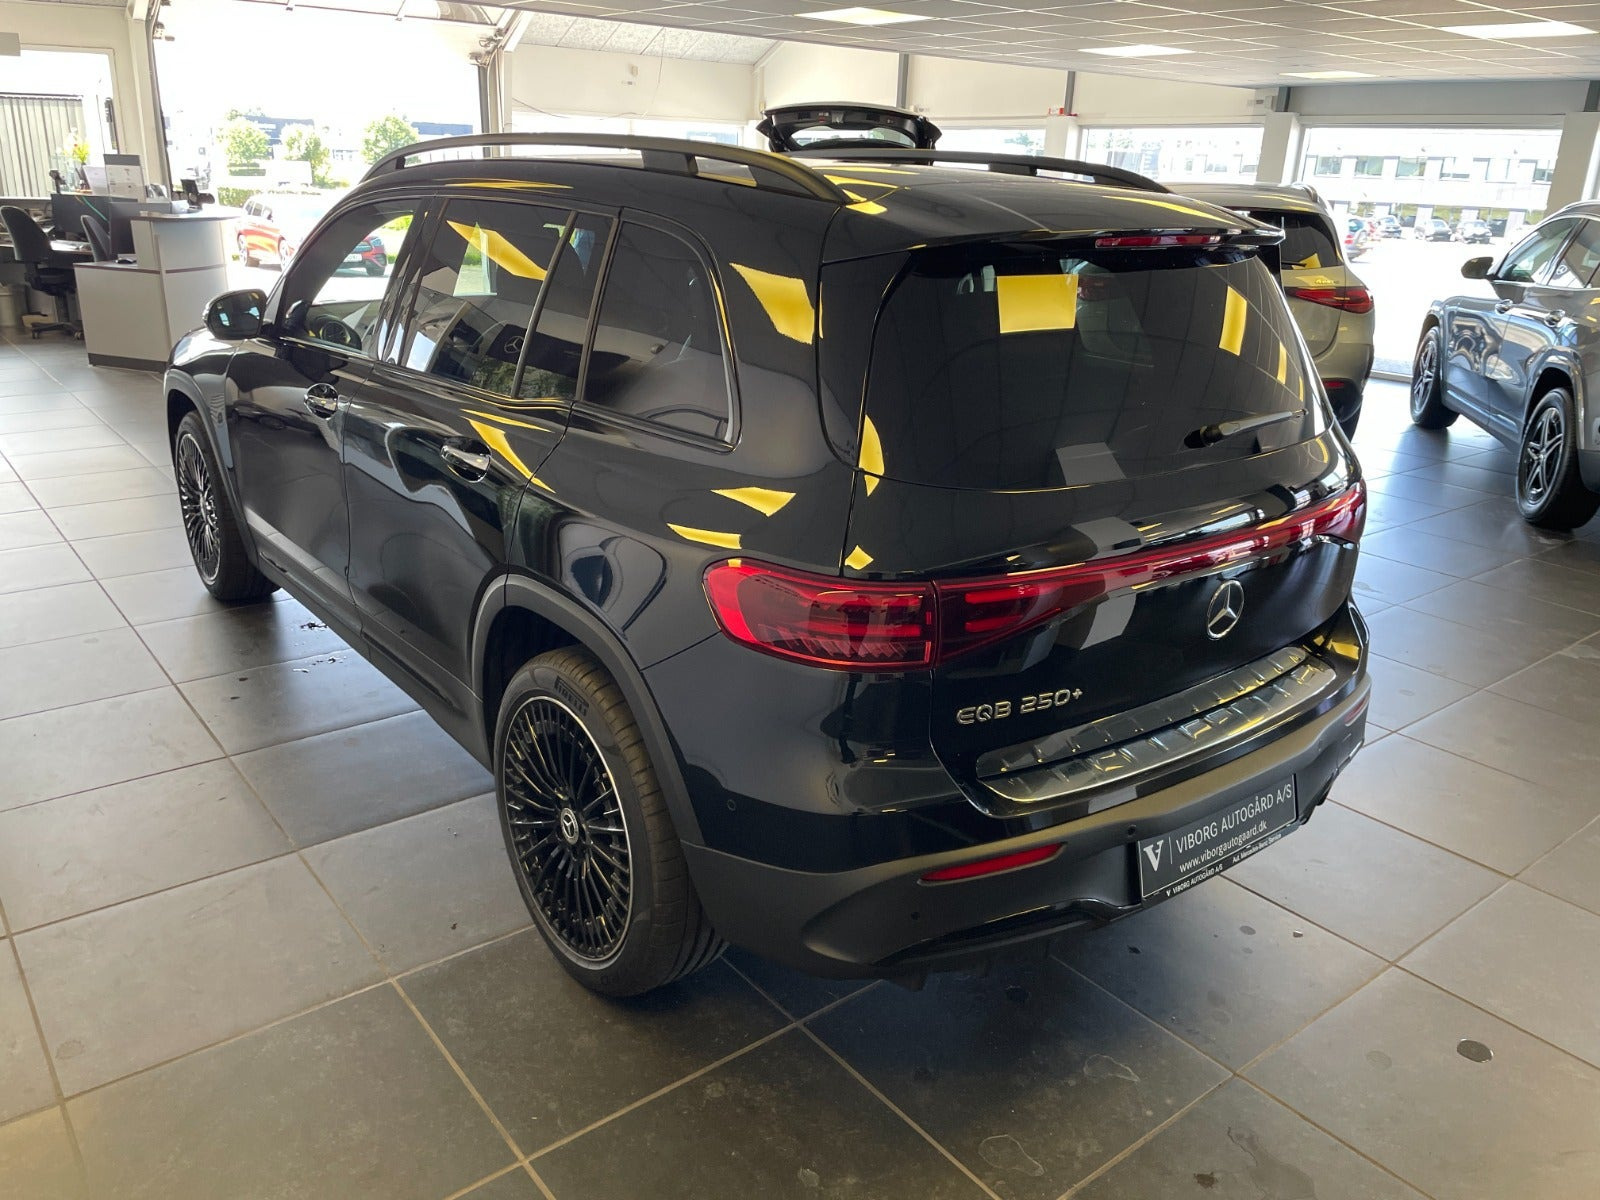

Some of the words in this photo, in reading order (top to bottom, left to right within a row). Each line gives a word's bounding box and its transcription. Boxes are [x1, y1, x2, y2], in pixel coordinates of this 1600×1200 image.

[956, 701, 1012, 725] EQB
[1020, 688, 1083, 714] 250+
[1176, 822, 1218, 853] VIBORG
[1221, 794, 1274, 833] AUTOGÅRD
[1276, 783, 1292, 804] A/S
[1179, 820, 1268, 873] www.viborgautogaard.dk
[1172, 880, 1191, 894] VIBORG
